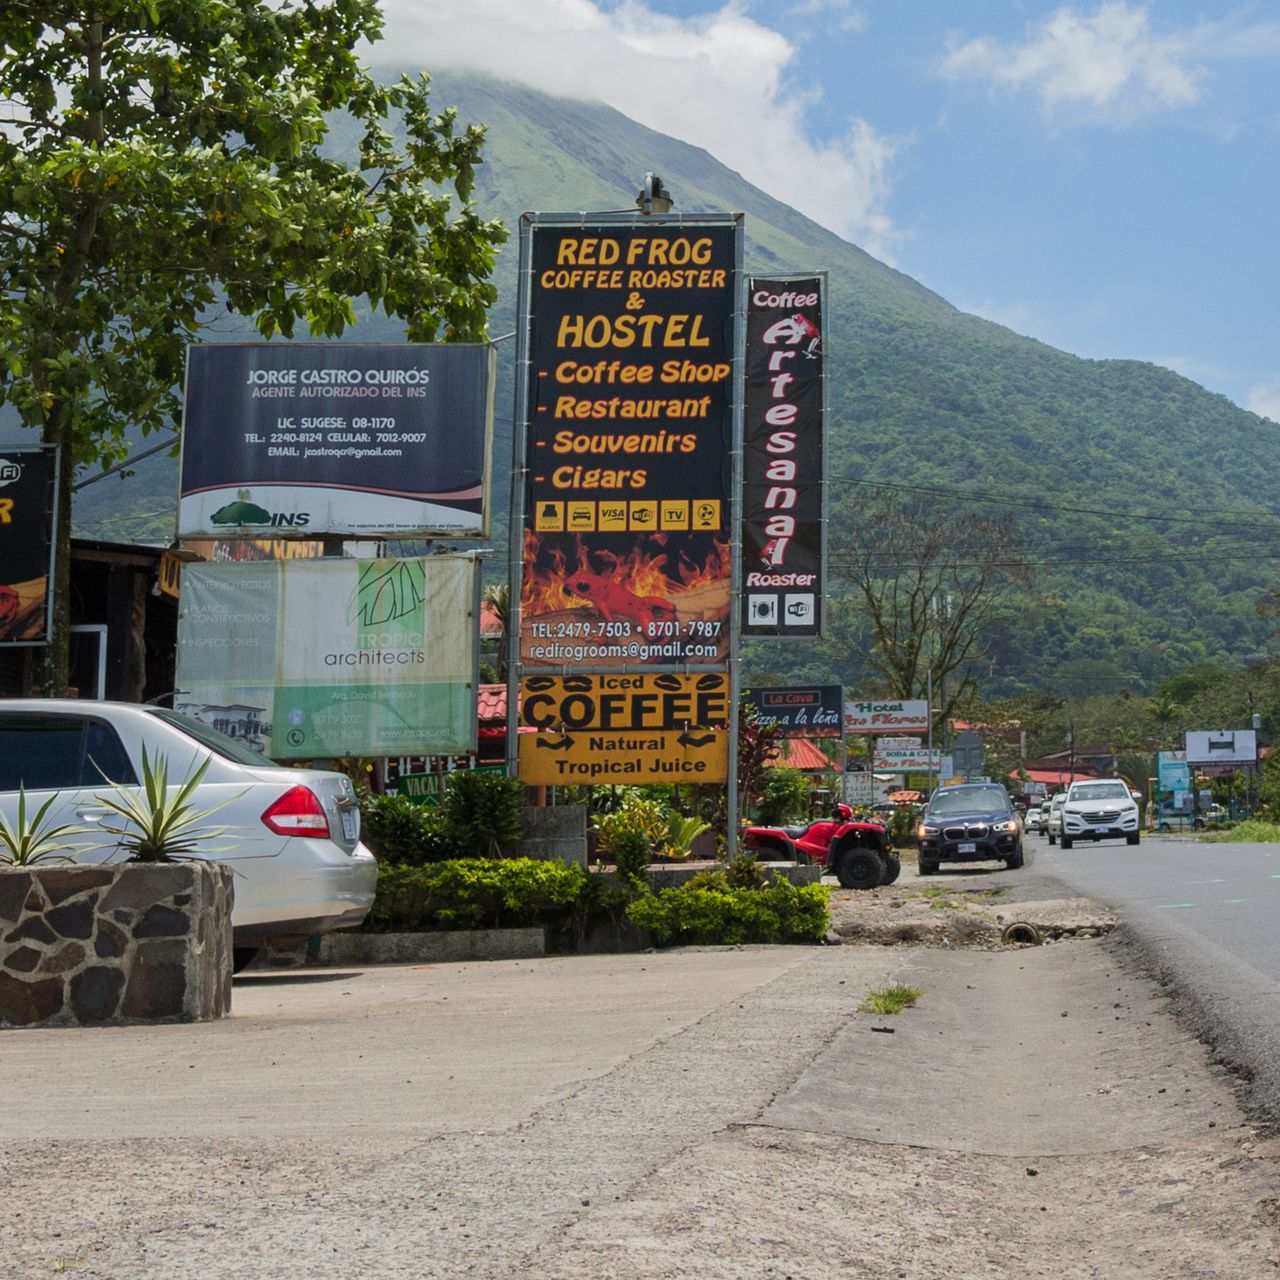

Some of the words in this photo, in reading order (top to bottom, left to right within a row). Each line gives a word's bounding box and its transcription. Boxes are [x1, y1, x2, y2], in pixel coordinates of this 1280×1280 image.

[557, 238, 620, 265] RED
[627, 237, 712, 265] FROG
[541, 270, 624, 289] COFFEE
[628, 269, 726, 288] ROASTER
[625, 291, 645, 310] &
[753, 291, 818, 308] Coffee
[556, 315, 710, 348] HOSTEL
[246, 369, 297, 385] JORGE
[300, 369, 362, 384] CASTRO
[365, 366, 429, 384] QUIRÓS
[555, 361, 654, 384] Coffee
[660, 360, 730, 383] Shop
[252, 387, 295, 398] AGENTE
[299, 386, 379, 397] AUTORIZADO
[382, 386, 403, 397] DEL
[407, 386, 426, 397] INS
[554, 395, 711, 419] Restaurant
[277, 418, 296, 429] LIC.
[301, 418, 346, 428] SUGESE:
[352, 418, 395, 428] 08-1170
[244, 433, 265, 443] TEL.:
[270, 433, 322, 442] 2240-8124
[327, 433, 371, 442] CELULAR:
[376, 433, 427, 442] 7012-9007
[553, 430, 696, 453] Souvenirs
[762, 317, 801, 566] Artesanal
[268, 447, 299, 456] EMAIL:
[552, 466, 647, 490] Cigars
[270, 513, 310, 526] INS
[601, 509, 624, 518] VISA
[667, 511, 683, 520] TV
[746, 572, 816, 587] Roaster
[532, 622, 631, 638] TEL:2479-7503
[647, 621, 721, 637] 8701-7987
[324, 649, 425, 666] architects
[530, 642, 717, 660] redfrogrooms@gmail.com
[600, 675, 644, 689] Iced
[770, 694, 782, 704] La
[786, 693, 814, 704] Cava
[522, 691, 726, 729] COFFEE
[795, 707, 807, 725] la
[855, 702, 905, 713] Hotel
[589, 736, 665, 751] Natural
[555, 759, 641, 777] Tropical
[648, 758, 706, 773] Juice
